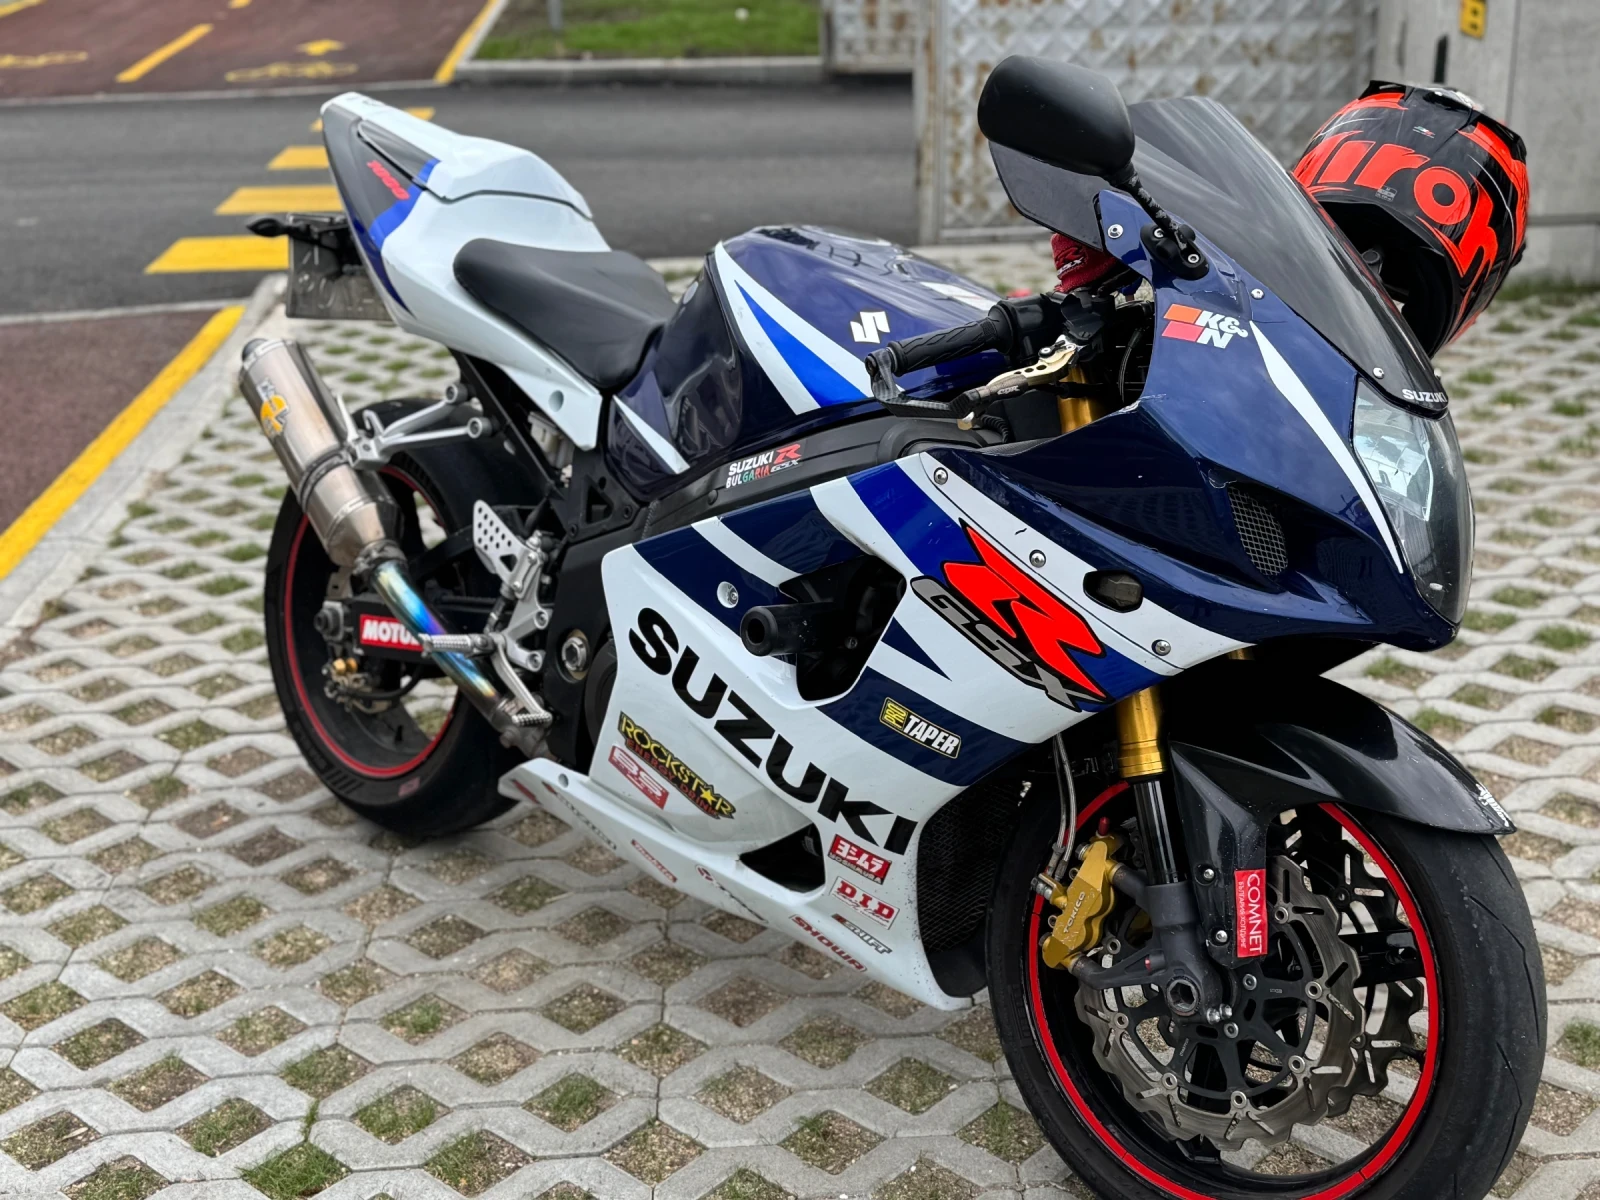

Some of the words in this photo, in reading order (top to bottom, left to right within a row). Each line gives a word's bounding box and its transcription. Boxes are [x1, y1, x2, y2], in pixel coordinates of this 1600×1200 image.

[1402, 388, 1448, 403] SUZUKI
[726, 465, 771, 489] BULGARIA
[728, 451, 774, 476] SUZUKI
[628, 607, 918, 856] SUZUKI
[883, 701, 907, 730] PRO
[903, 714, 960, 755] TAPER
[627, 738, 676, 782] ENERGY
[680, 783, 719, 816] DRINK
[835, 840, 885, 873] ヨシムラ
[1063, 891, 1086, 933] TOKICO
[1238, 881, 1246, 915] БЪЛГАРИЯ
[1247, 873, 1263, 954] COMNET
